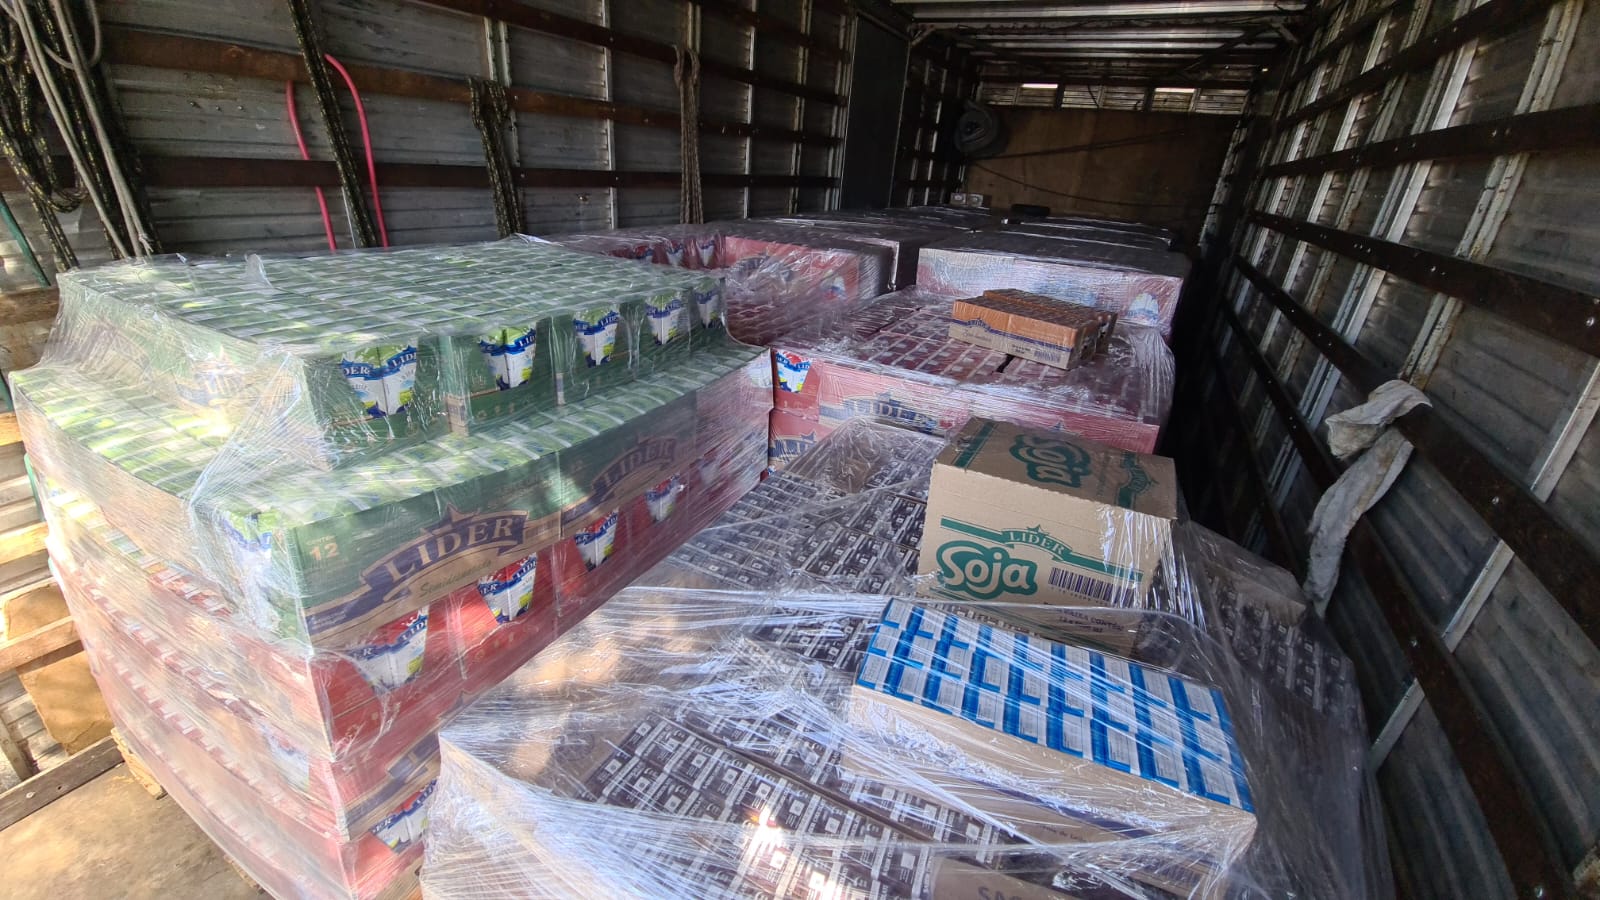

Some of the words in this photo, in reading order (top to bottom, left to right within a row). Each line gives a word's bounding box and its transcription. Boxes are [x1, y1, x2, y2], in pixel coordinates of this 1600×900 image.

[310, 543, 340, 560] 12
[384, 518, 513, 582] LIDER
[1010, 531, 1065, 555] LIDER
[940, 544, 1033, 596] Soja
